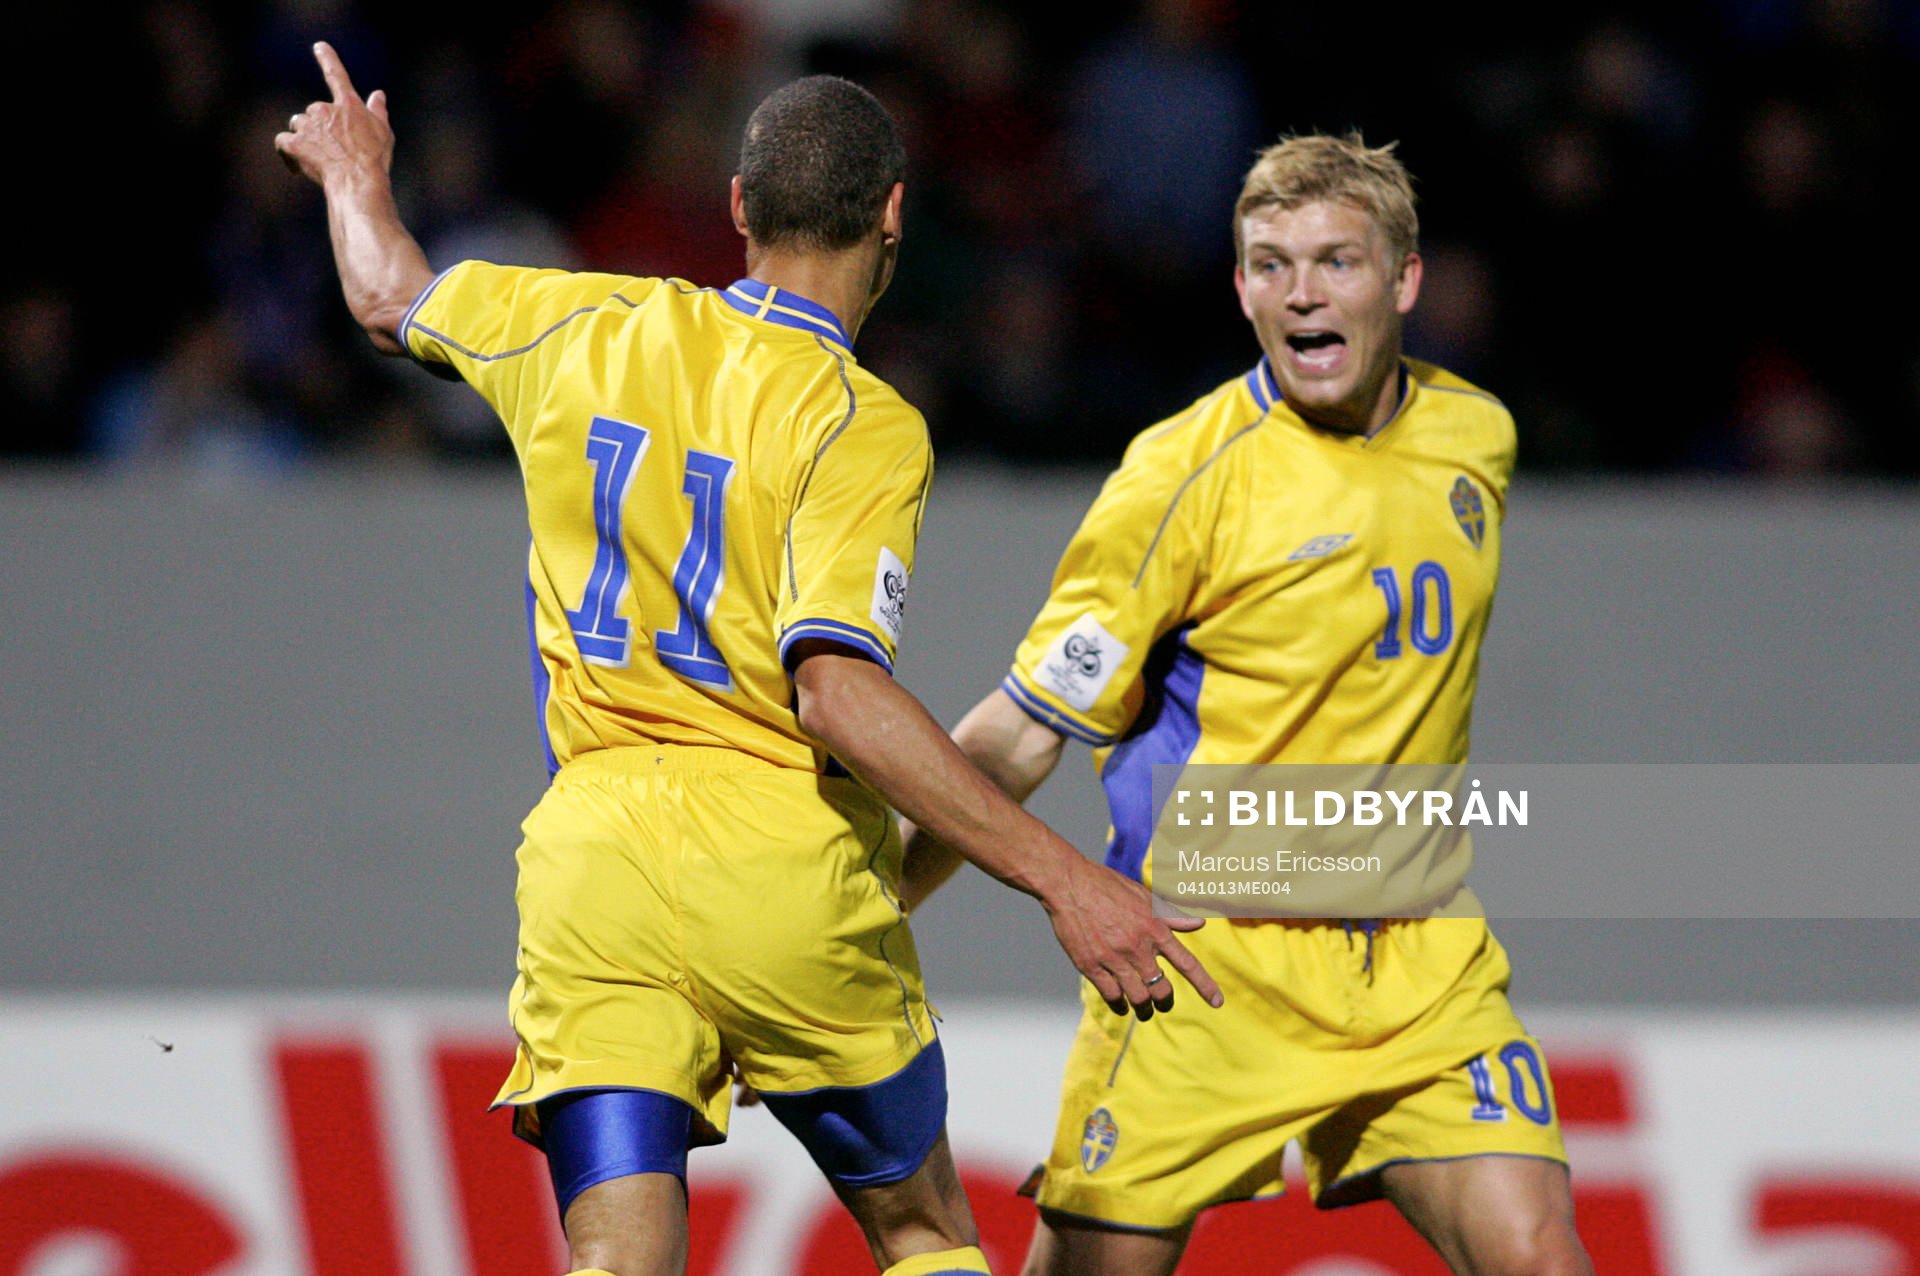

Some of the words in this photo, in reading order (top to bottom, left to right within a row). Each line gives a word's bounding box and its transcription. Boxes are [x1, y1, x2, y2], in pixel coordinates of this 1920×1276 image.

[565, 415, 738, 693] 11
[1372, 560, 1453, 660] 10
[1466, 1040, 1552, 1126] 10
